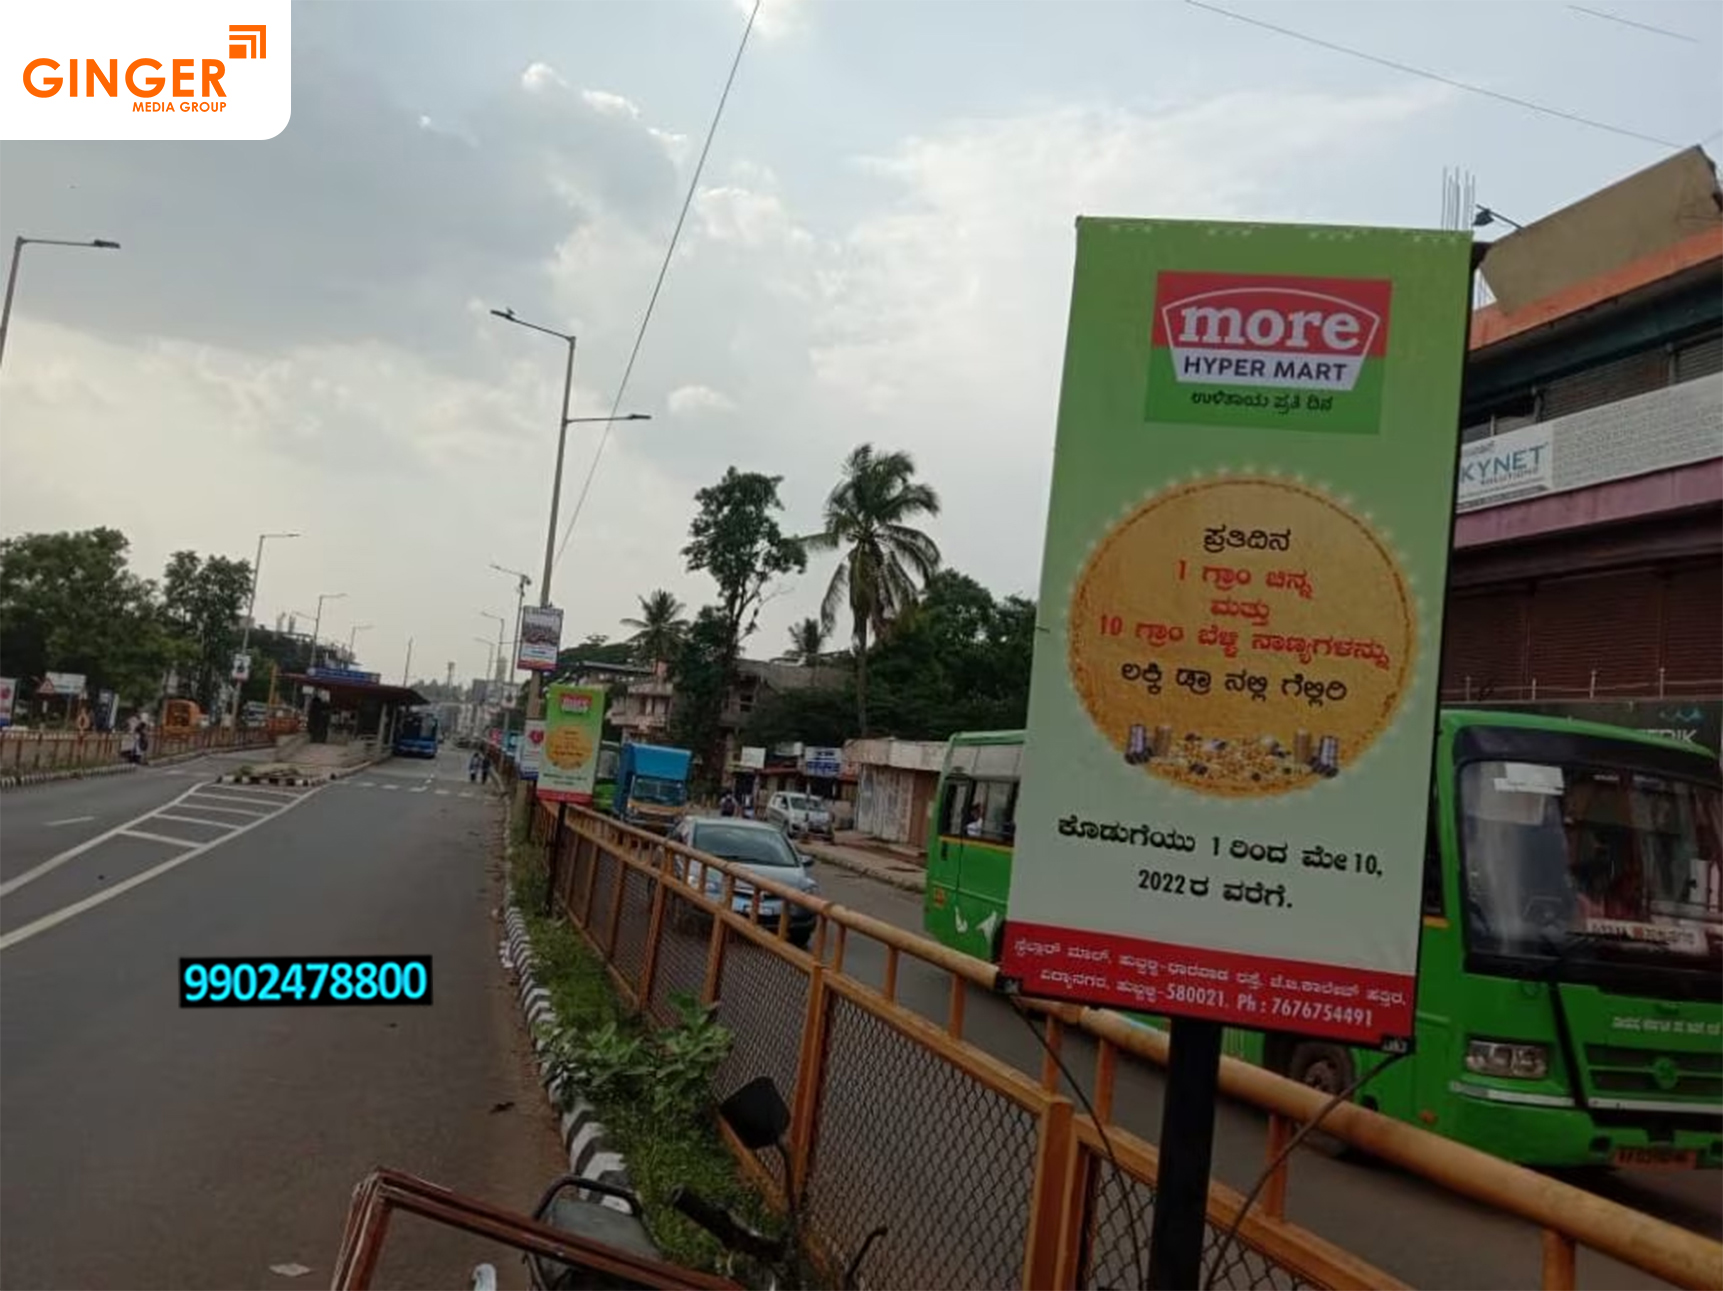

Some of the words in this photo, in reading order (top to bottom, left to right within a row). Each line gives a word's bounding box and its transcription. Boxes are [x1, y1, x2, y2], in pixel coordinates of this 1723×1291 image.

[1178, 305, 1362, 350] more
[1184, 356, 1265, 377] HYPER
[1273, 361, 1347, 382] MART
[1461, 445, 1544, 484] KYNET
[1202, 525, 1291, 553] ಪ್ರತಿದಿನ
[1175, 559, 1187, 581] 1
[1202, 565, 1251, 591] ಗ್ರಾಂ
[1265, 568, 1315, 599] ಚಿನ್ನ
[1211, 597, 1270, 626] ಮತ್ತು
[1100, 614, 1123, 637] 10
[1135, 620, 1184, 647] ಗ್ರಾಂ
[1197, 624, 1239, 658] ಬೆಳ್ಳಿ
[1121, 660, 1162, 695] ಲಕ್ಕಿ
[1175, 665, 1212, 694] ಡ್ರಾ
[1225, 670, 1267, 702] ನಲ್ಲಿ
[1281, 673, 1347, 706] ಗೆಲ್ಲಿರಿ
[1057, 814, 1196, 853] ಕೊಡುಗೆಯು
[1211, 836, 1221, 857] 1
[1229, 837, 1288, 866] ರಿಂದ
[1271, 997, 1374, 1028] 7676754491
